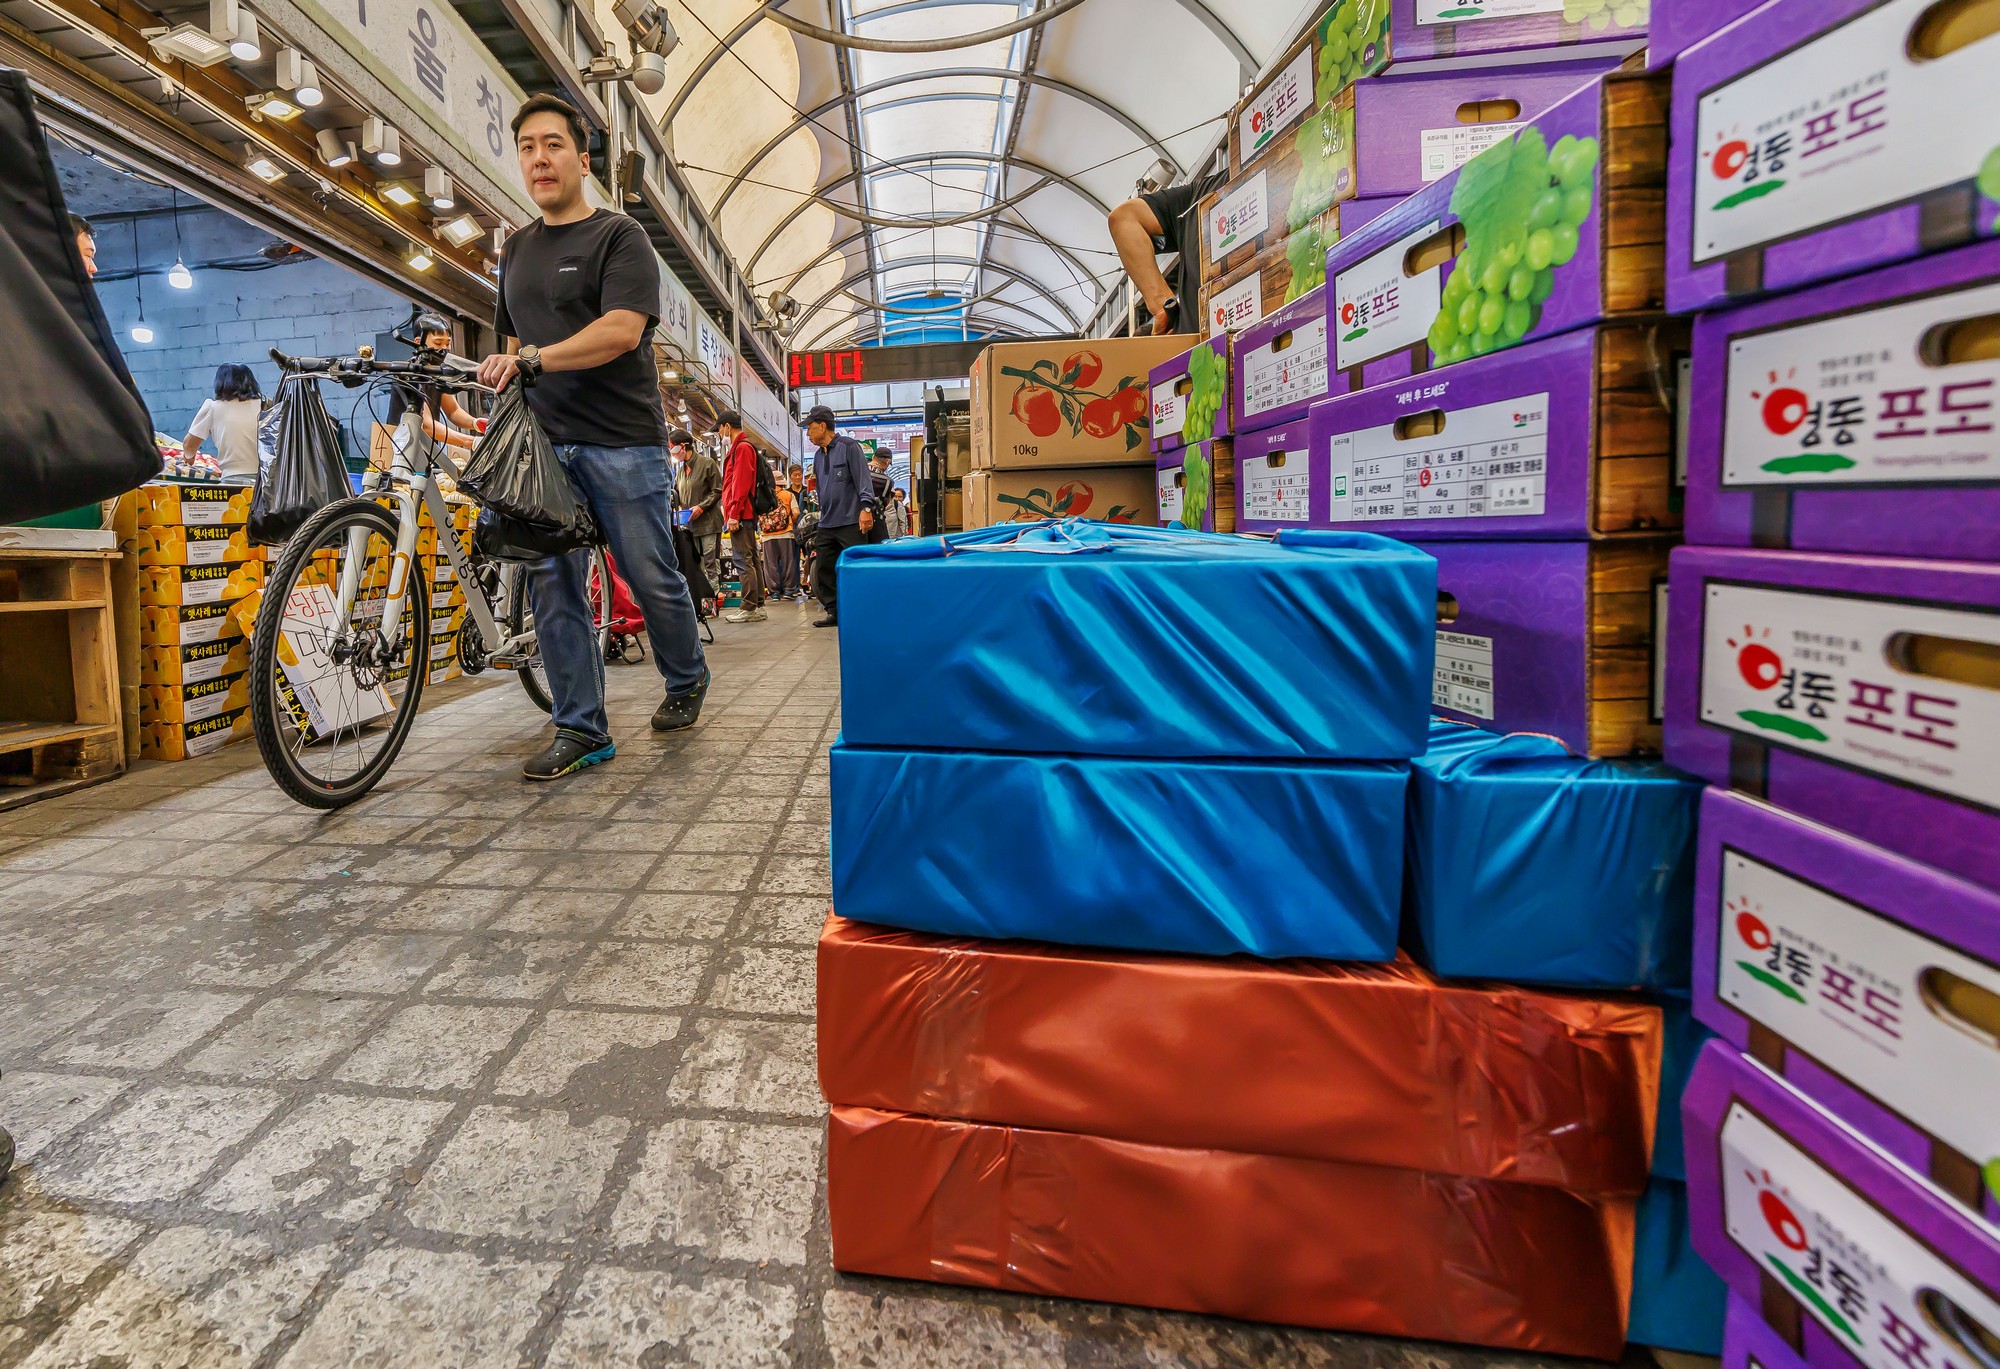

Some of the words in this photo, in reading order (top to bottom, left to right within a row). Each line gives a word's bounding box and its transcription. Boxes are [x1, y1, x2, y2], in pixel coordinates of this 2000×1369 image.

[358, 0, 504, 157] 울청
[1251, 105, 1274, 134] 영동
[1276, 82, 1298, 119] 포도
[1711, 130, 1792, 183] 영동
[1799, 88, 1888, 159] 포도
[1218, 213, 1238, 236] 영동
[1239, 198, 1258, 226] 포도
[1216, 307, 1235, 328] 영동
[1236, 297, 1253, 321] 포도
[1341, 302, 1370, 329] 영동
[1372, 286, 1400, 318] 포도
[1413, 389, 1422, 402] 후
[1762, 387, 1865, 448] 영동
[1874, 379, 1995, 440] 포도
[1012, 444, 1039, 457] 10kg
[1470, 465, 1484, 477] 주소
[1737, 643, 1837, 720] 영동
[1845, 679, 1960, 751] 포도
[1735, 911, 1813, 988] 영동
[1819, 964, 1903, 1040] 포도
[1758, 1189, 1869, 1324] 영동
[1879, 1303, 1956, 1369] 포
